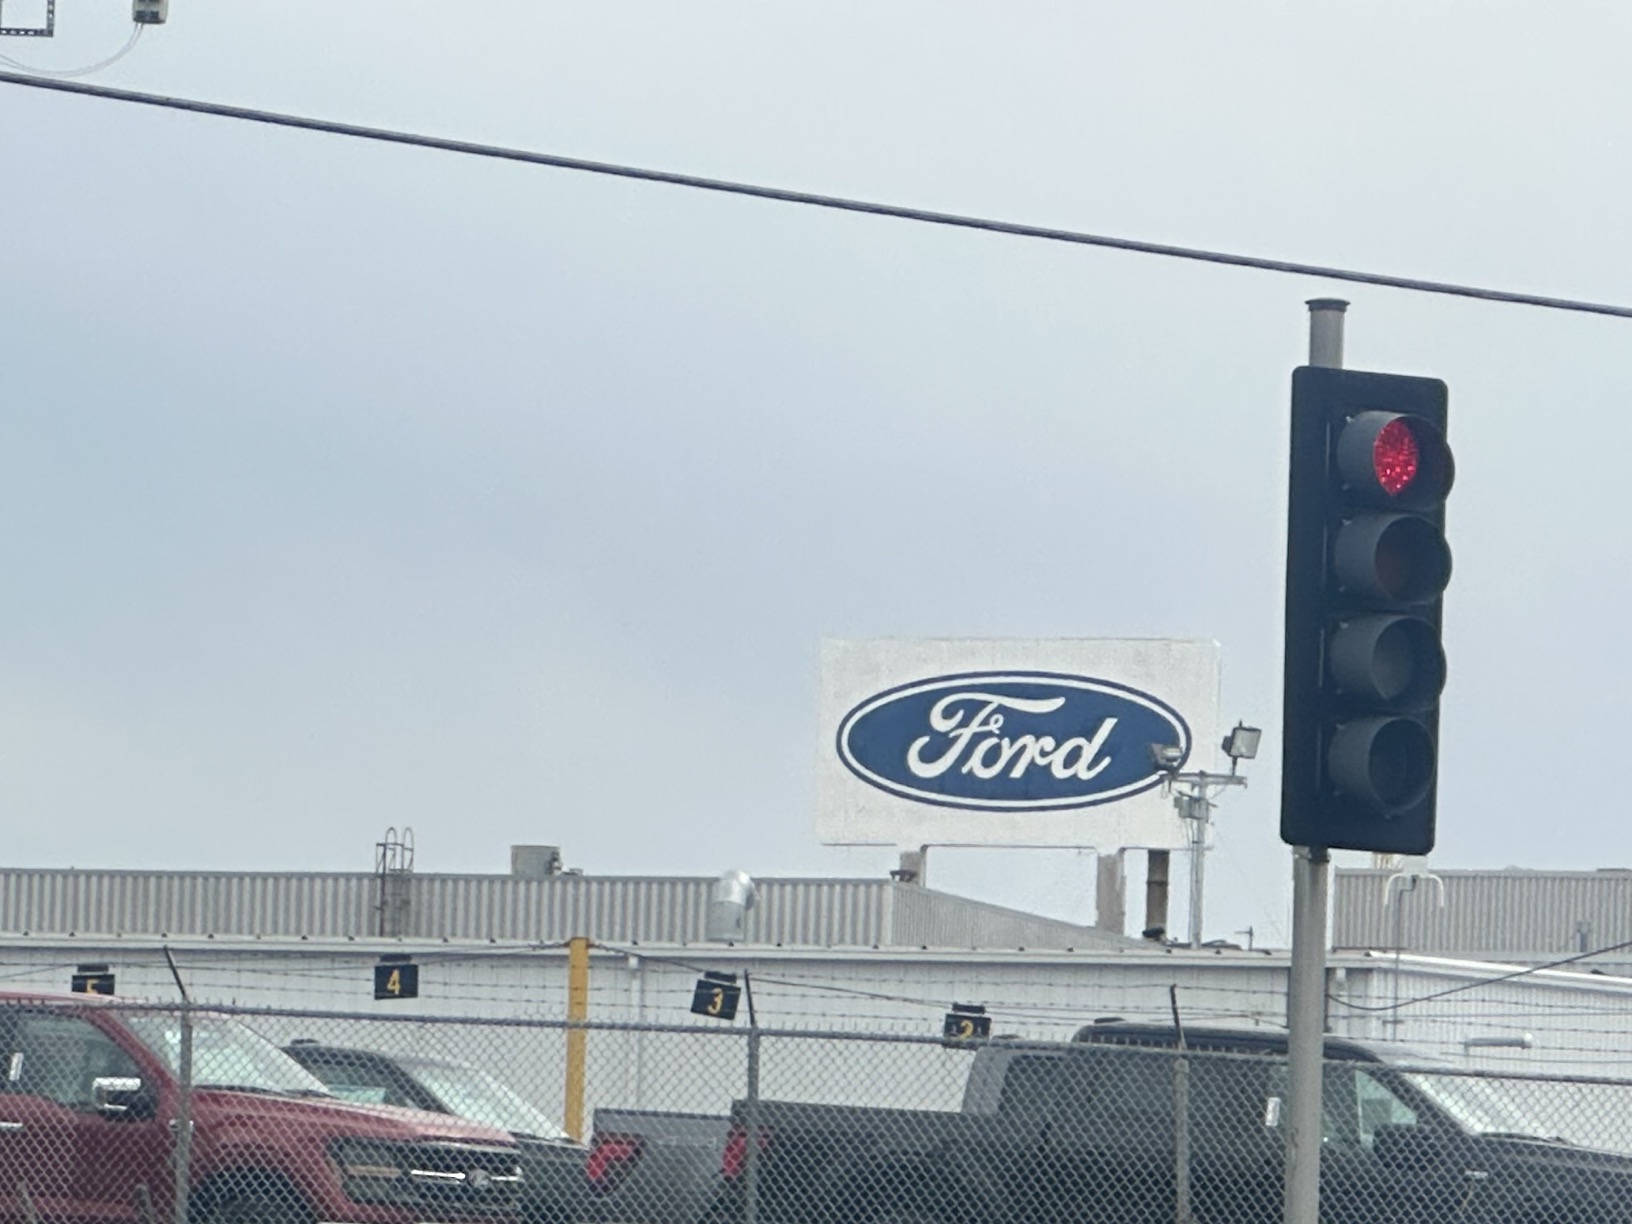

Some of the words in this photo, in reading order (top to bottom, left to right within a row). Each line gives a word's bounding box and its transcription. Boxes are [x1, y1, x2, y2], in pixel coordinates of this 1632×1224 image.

[907, 692, 1118, 781] Ford
[386, 969, 401, 995] 4
[708, 987, 723, 1015] 3
[959, 1019, 974, 1040] 2
